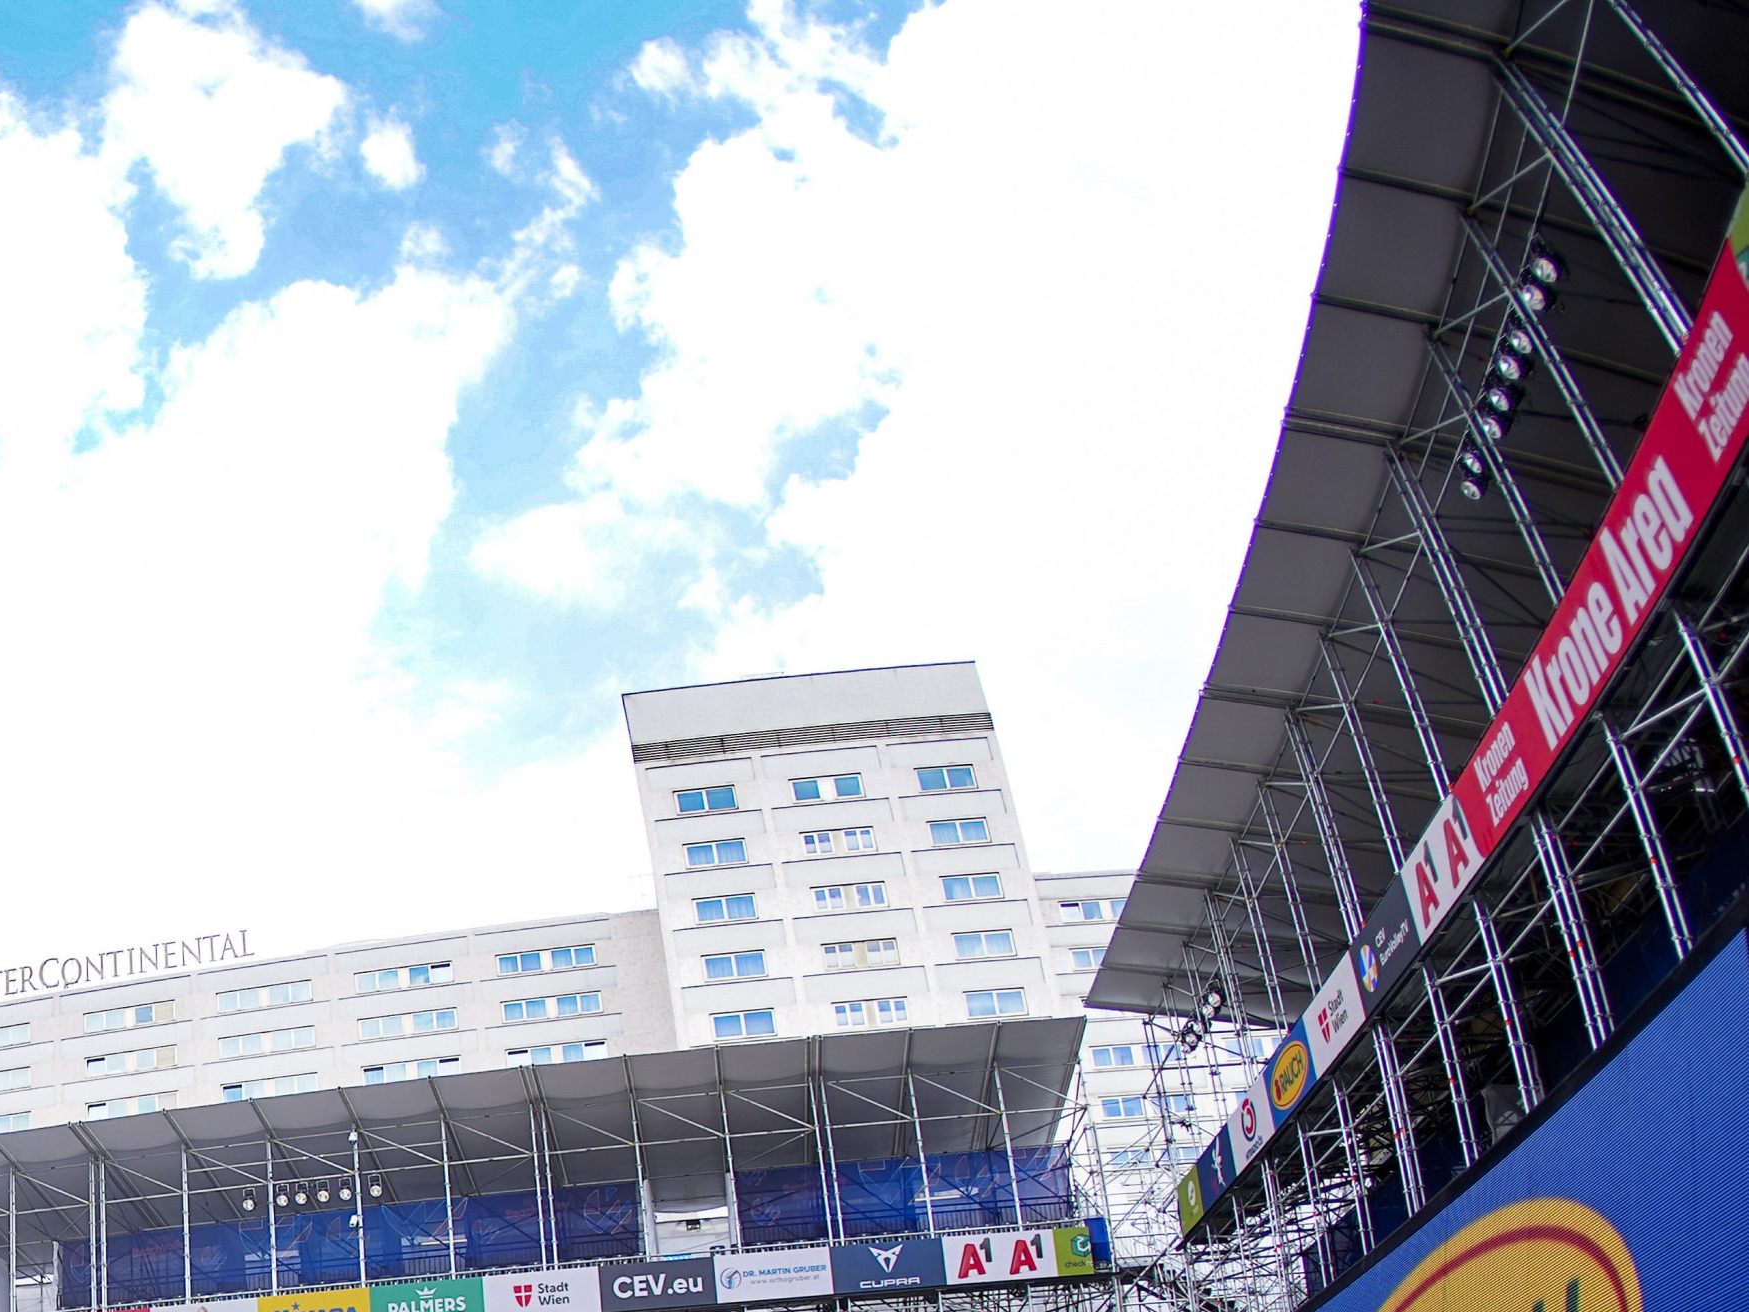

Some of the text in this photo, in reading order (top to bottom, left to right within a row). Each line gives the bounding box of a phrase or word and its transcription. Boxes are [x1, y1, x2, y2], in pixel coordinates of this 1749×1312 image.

[1673, 311, 1734, 421] Kronen
[1698, 352, 1749, 462] Zeitun
[1524, 581, 1624, 750] Krone
[1474, 721, 1515, 793] Kronen
[1486, 757, 1529, 828] Zeitung
[1375, 927, 1385, 948] CEV
[1328, 988, 1344, 1017] Stadt
[1332, 1009, 1348, 1033] Wien
[1279, 1050, 1304, 1093] RAUCH
[742, 1264, 827, 1278] DR. MARTIN GRUBER
[958, 1238, 992, 1279] A1
[1010, 1234, 1043, 1275] A1
[538, 1282, 569, 1294] Stadt
[538, 1294, 569, 1306] Wien
[613, 1274, 702, 1299] CEV.eu
[860, 1276, 921, 1289] CUPRA
